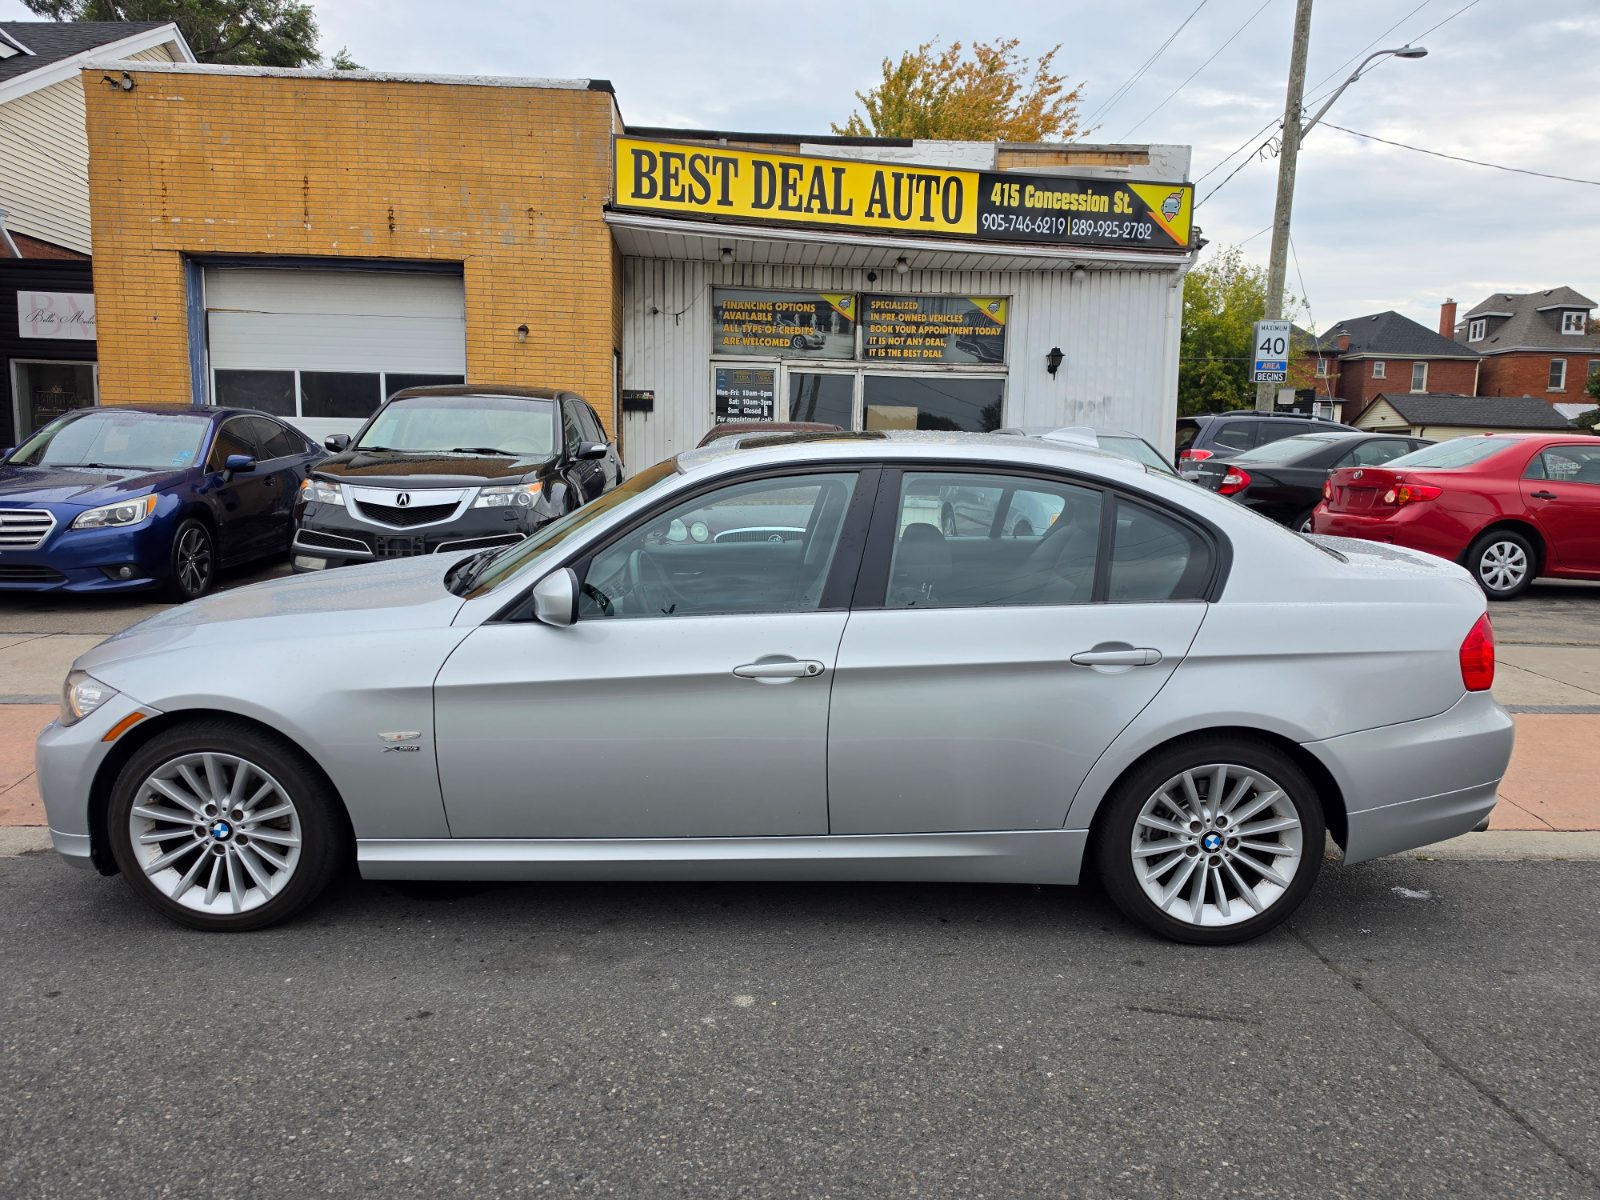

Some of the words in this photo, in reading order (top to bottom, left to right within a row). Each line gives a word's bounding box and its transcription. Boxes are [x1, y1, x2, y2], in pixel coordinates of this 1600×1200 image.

[630, 148, 739, 206] BEST
[751, 159, 854, 217] DEAL
[865, 169, 964, 225] AUTO
[990, 182, 1020, 207] 415
[1025, 184, 1109, 214] Concession
[1113, 190, 1133, 214] St.
[982, 213, 1066, 235] 905-746-6219
[1072, 218, 1152, 240] 289-925-2782
[722, 300, 773, 311] FINANCING
[775, 302, 816, 313] OPTIONS
[871, 301, 918, 310] SPECIALIZED
[25, 308, 56, 324] Bella
[723, 311, 773, 321] AVAILABLE
[870, 312, 879, 321] IN
[881, 313, 927, 322] PRE-OWNED
[929, 314, 963, 323] VEHICLES
[723, 323, 739, 333] ALL
[741, 324, 762, 333] TYPE
[765, 324, 777, 333] OF
[779, 325, 815, 336] CREDITS
[870, 325, 894, 333] BOOK
[895, 325, 916, 334] YOUR
[918, 326, 973, 335] APPOINTMENT
[975, 327, 1001, 336] TODAY
[723, 336, 741, 345] ARE
[742, 337, 791, 347] WELCOMED
[878, 337, 886, 345] IS
[906, 338, 923, 346] ANY
[1259, 337, 1286, 355] 40
[869, 349, 877, 357] IT
[878, 349, 886, 357] IS
[887, 349, 901, 357] THE
[903, 349, 921, 358] BEST
[923, 350, 943, 358] DEAL
[1257, 372, 1284, 381] BEGINS
[743, 407, 762, 415] Closed
